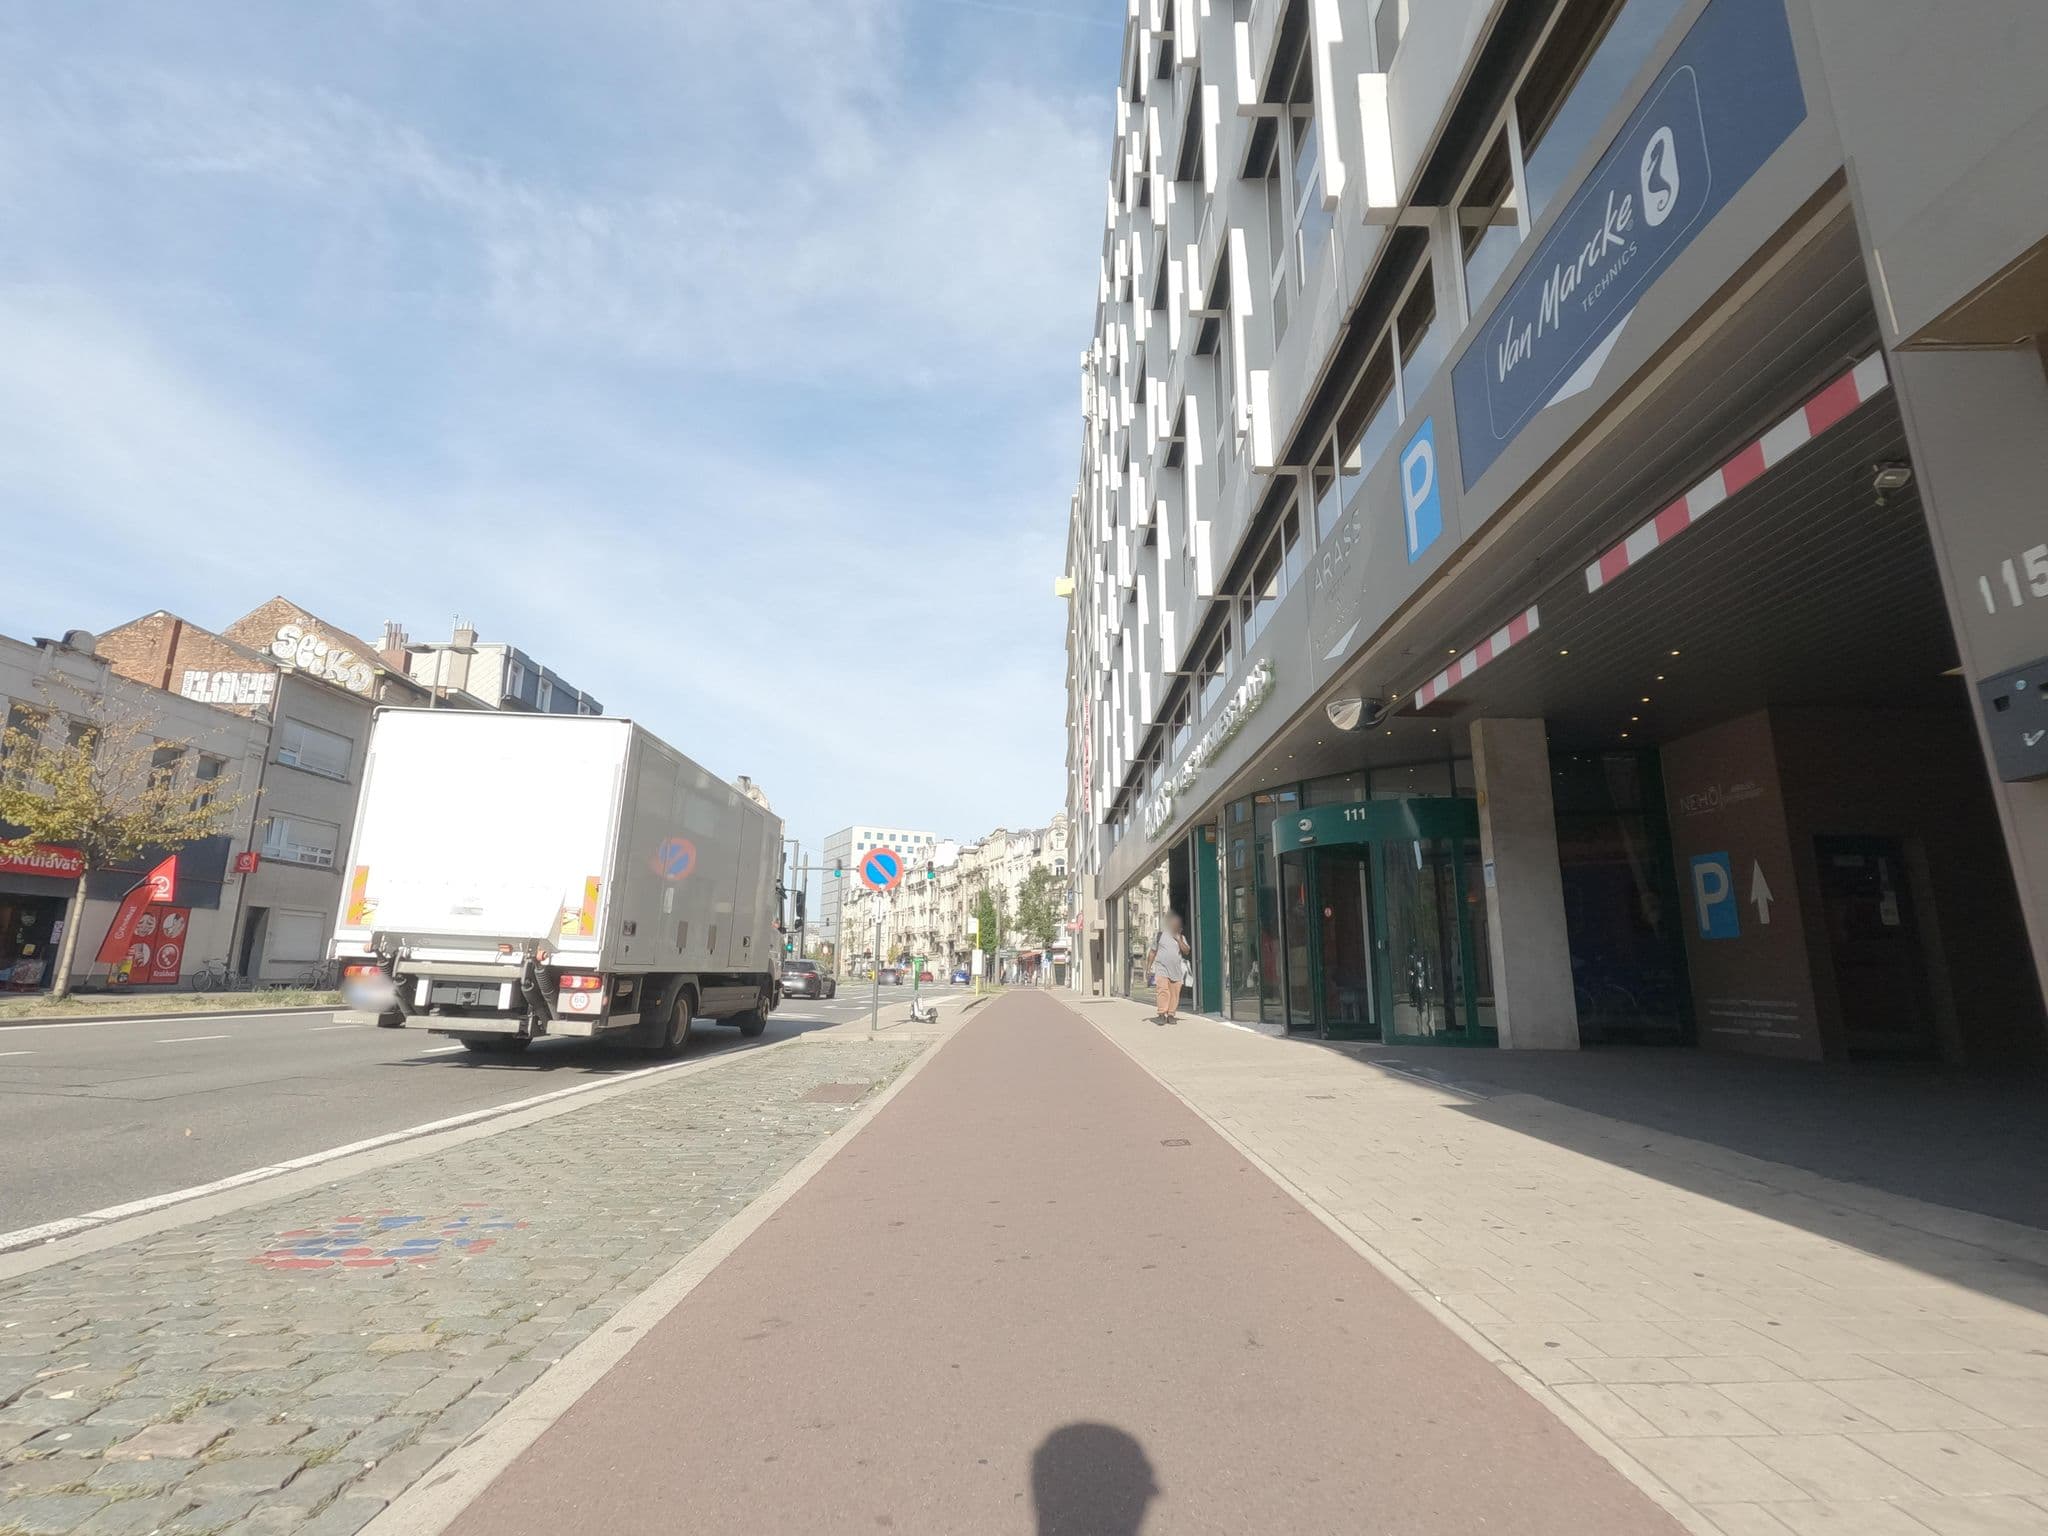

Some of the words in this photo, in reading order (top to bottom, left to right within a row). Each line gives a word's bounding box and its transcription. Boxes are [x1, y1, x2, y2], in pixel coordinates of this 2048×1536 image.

[1499, 315, 1532, 384] Van
[1537, 190, 1632, 338] Marcke
[1582, 240, 1639, 312] TECHNICS
[1403, 439, 1434, 554] P
[1315, 508, 1361, 591] ARASS
[1978, 543, 2048, 615] 115
[1343, 808, 1366, 821] 111
[13, 853, 78, 871] Kruidvat
[1694, 862, 1729, 931] P
